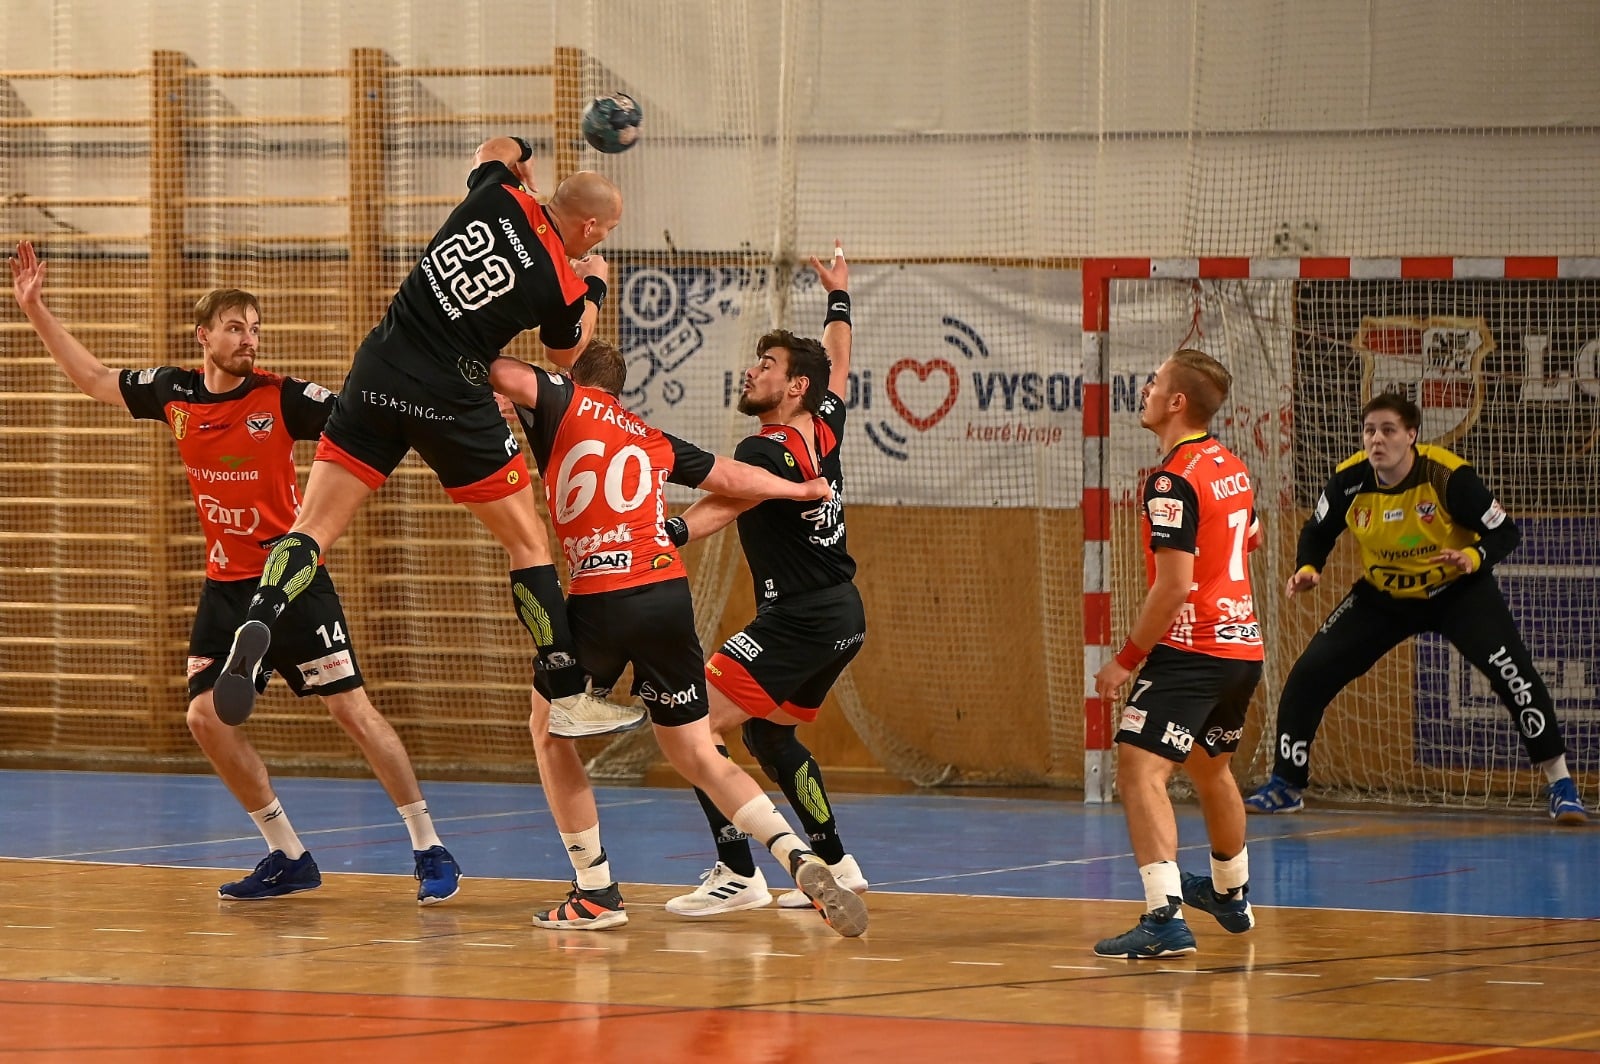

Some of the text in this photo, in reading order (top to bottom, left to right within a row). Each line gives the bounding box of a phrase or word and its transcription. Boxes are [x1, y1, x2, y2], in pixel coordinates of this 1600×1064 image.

[499, 217, 534, 269] JONSSON
[431, 220, 515, 311] 23
[421, 257, 463, 320] Glanzstoff
[361, 390, 434, 420] TESASING
[973, 371, 1152, 413] VYSON
[556, 440, 652, 525] 60
[209, 539, 229, 569] 4
[1228, 509, 1248, 582] 7
[316, 621, 346, 648] 14
[660, 683, 699, 709] sport
[1131, 679, 1153, 702] 7
[1488, 646, 1532, 706] sport
[1280, 733, 1308, 767] 66
